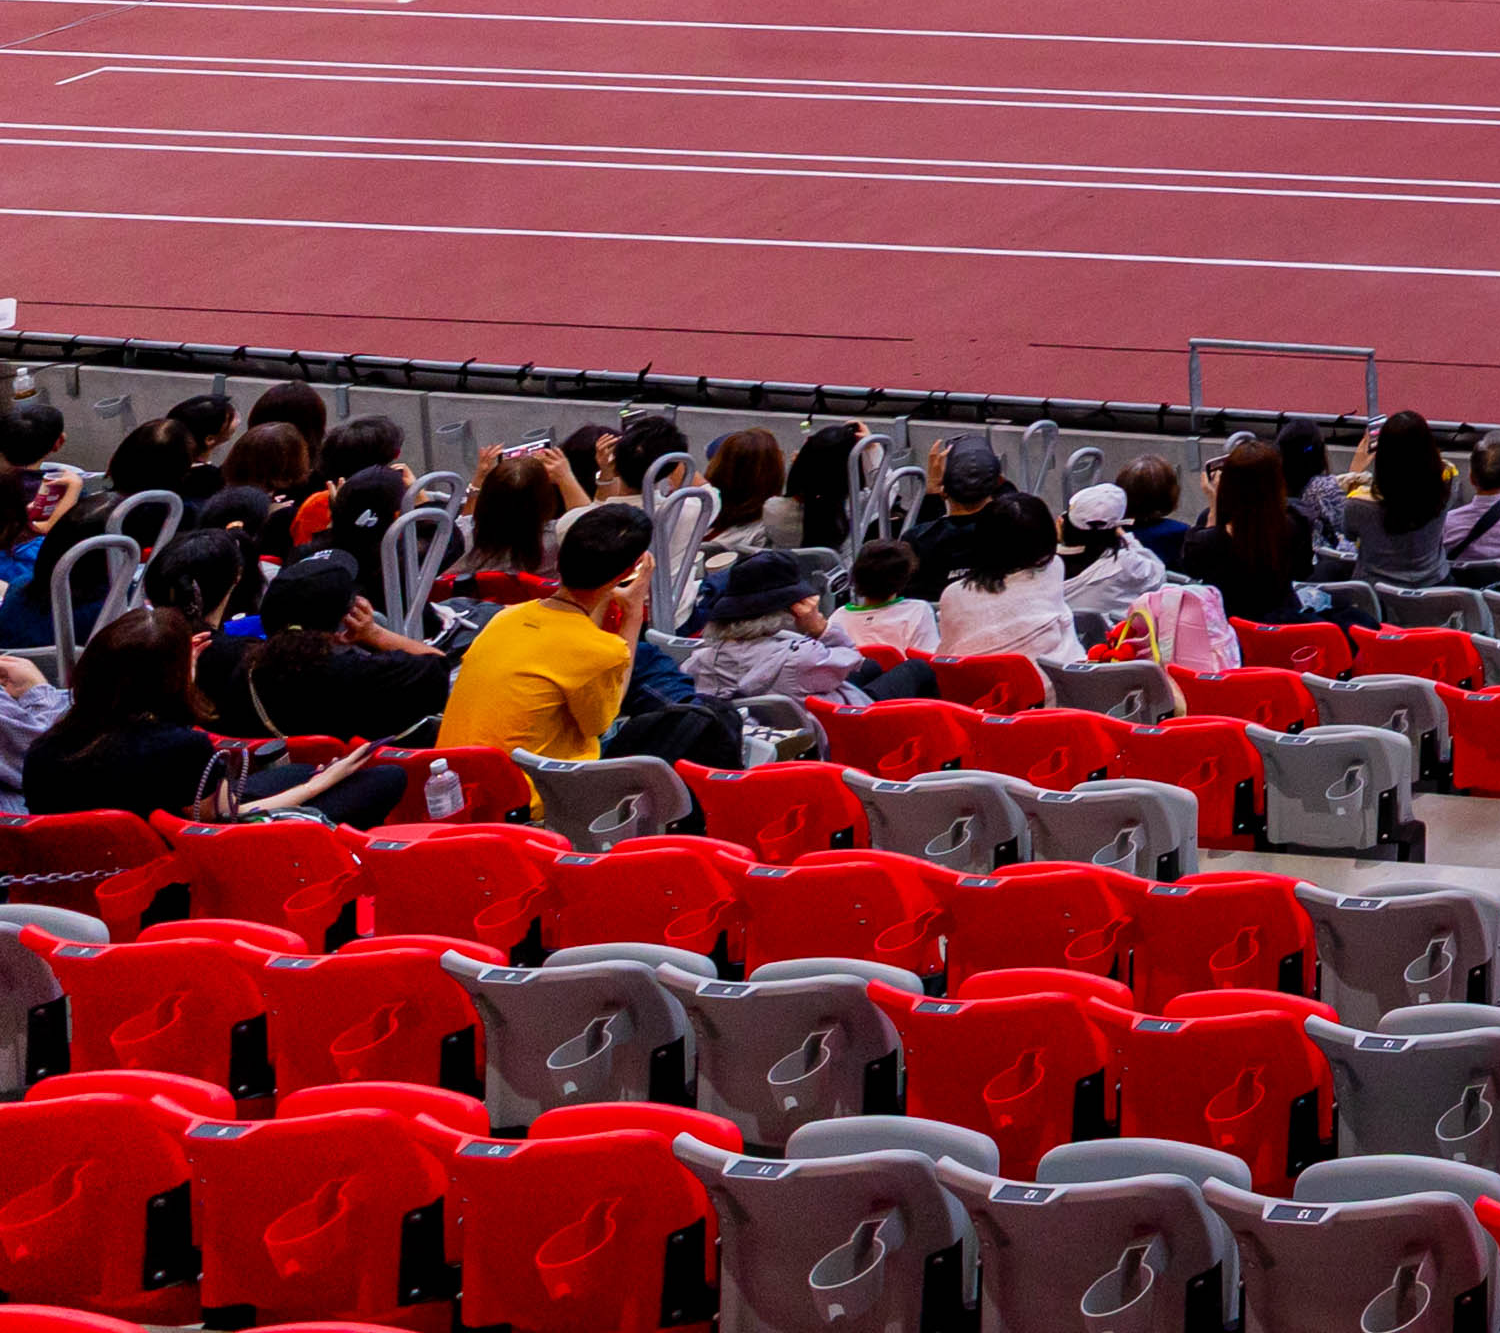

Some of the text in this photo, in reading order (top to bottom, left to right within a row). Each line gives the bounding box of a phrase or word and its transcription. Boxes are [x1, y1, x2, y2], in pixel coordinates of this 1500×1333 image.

[217, 1127, 229, 1136] 9
[488, 1145, 504, 1154] 10
[758, 1165, 772, 1174] 11
[1024, 1190, 1038, 1198] 12
[1297, 1210, 1311, 1218] 13
